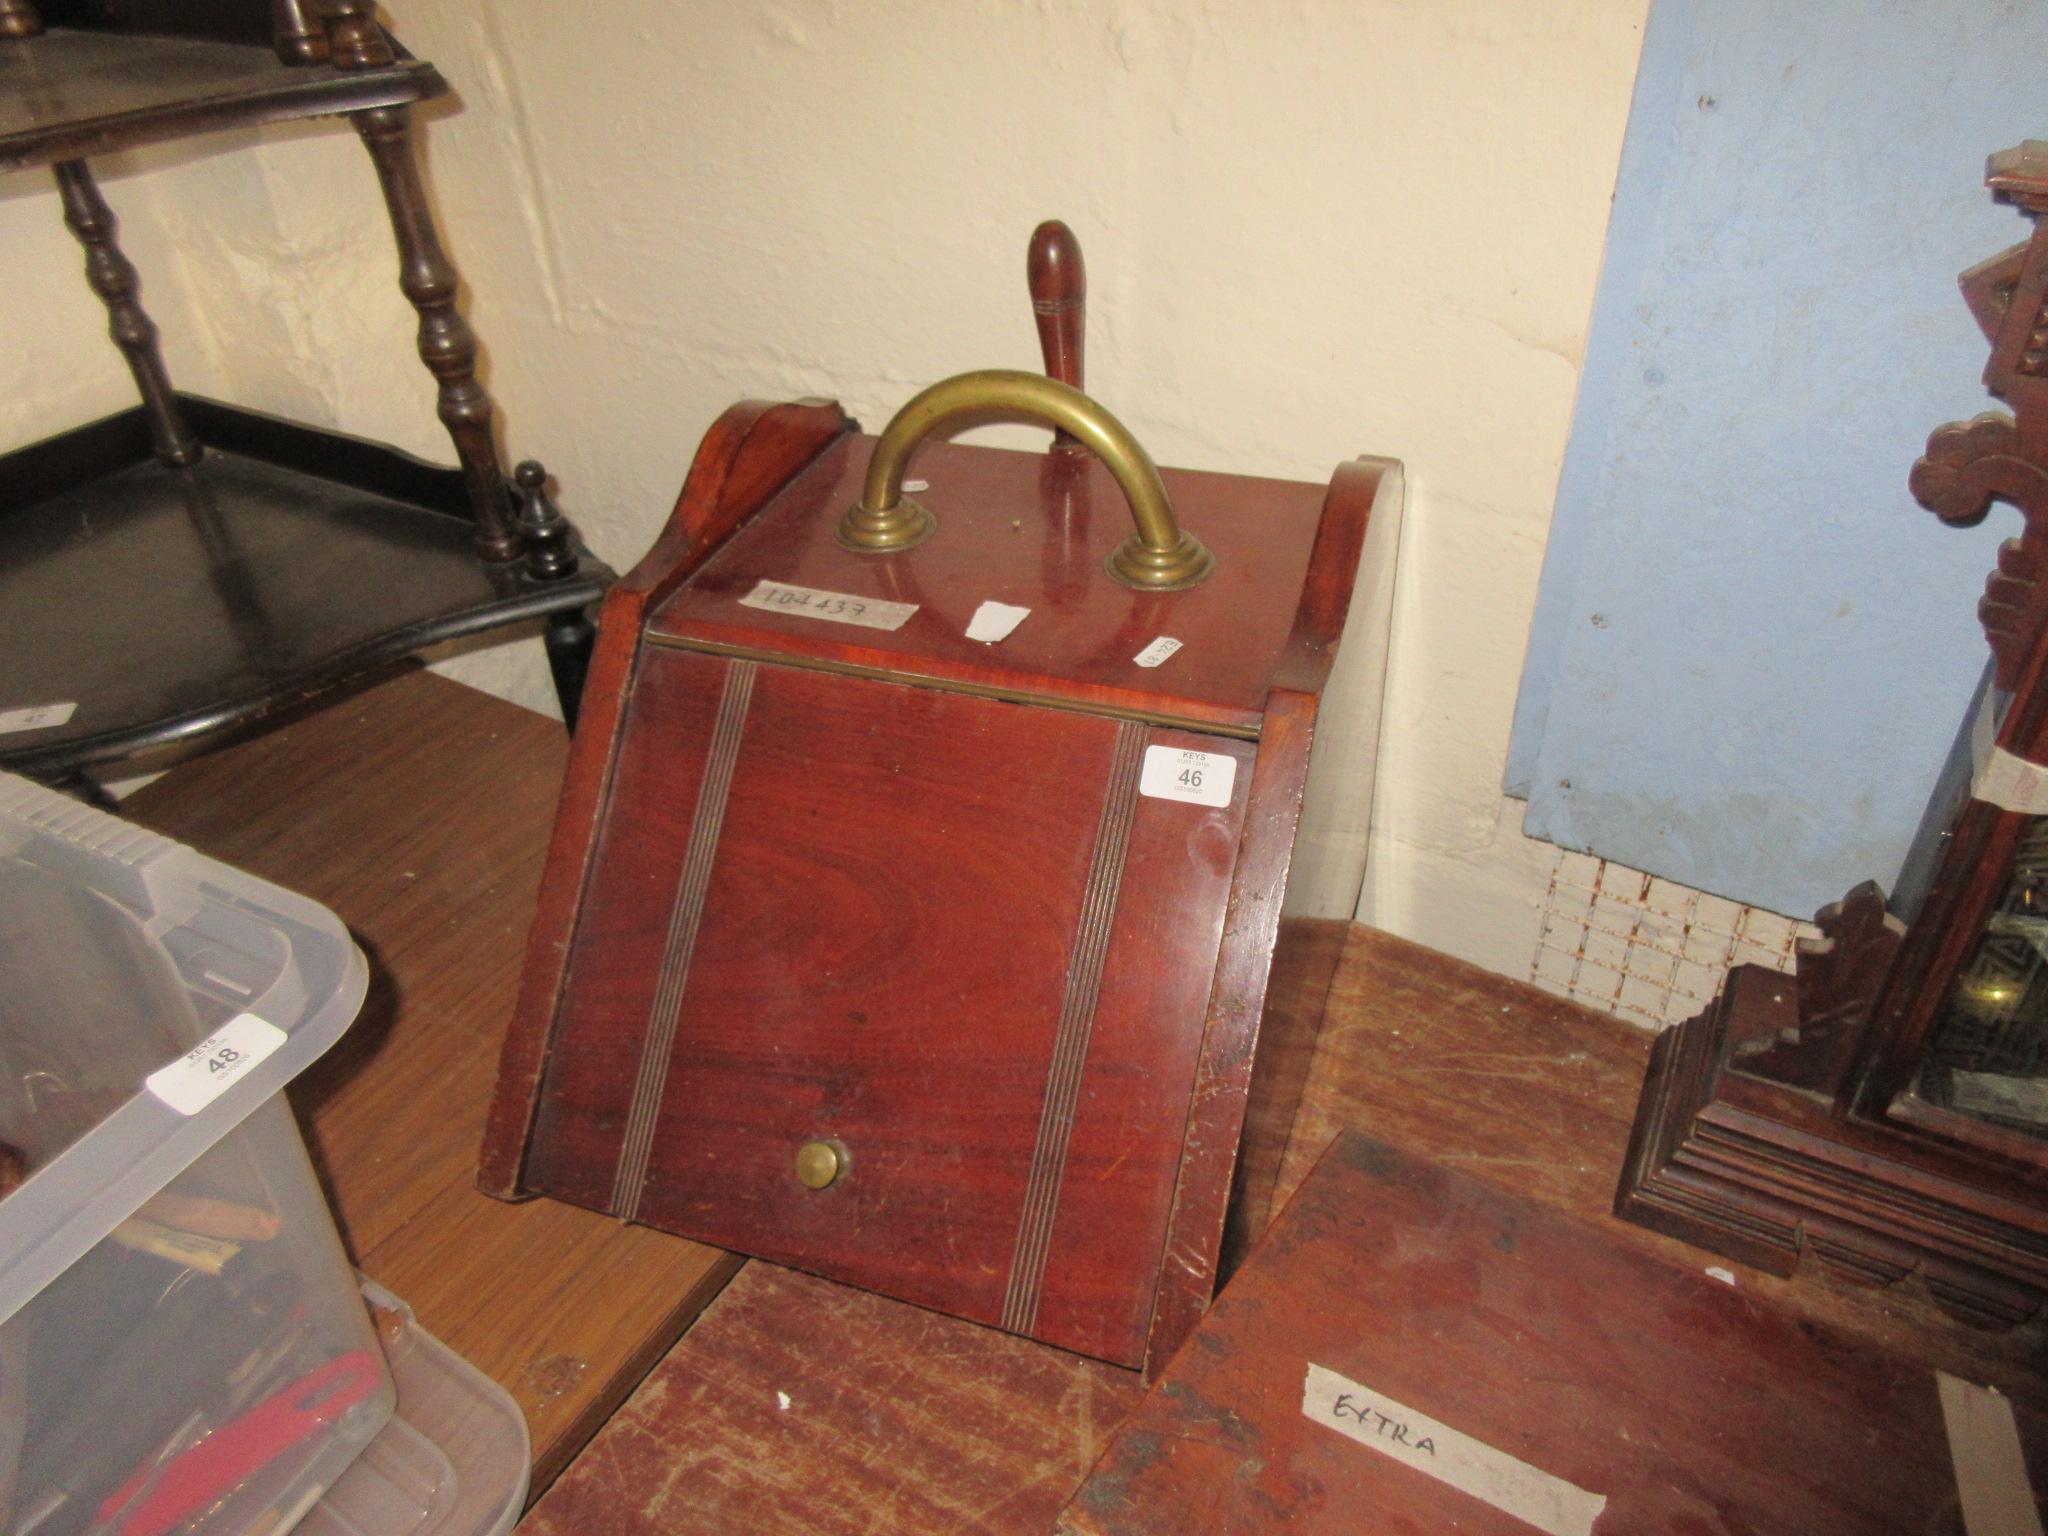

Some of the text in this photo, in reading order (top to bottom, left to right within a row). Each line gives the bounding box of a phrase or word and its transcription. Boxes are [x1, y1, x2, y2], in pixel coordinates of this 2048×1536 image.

[764, 588, 867, 617] 104437
[1182, 751, 1207, 761] KEYS
[1178, 769, 1203, 787] 46
[187, 1038, 217, 1061] KEYS
[209, 1048, 240, 1073] 48
[1333, 1394, 1436, 1456] EXTRA
